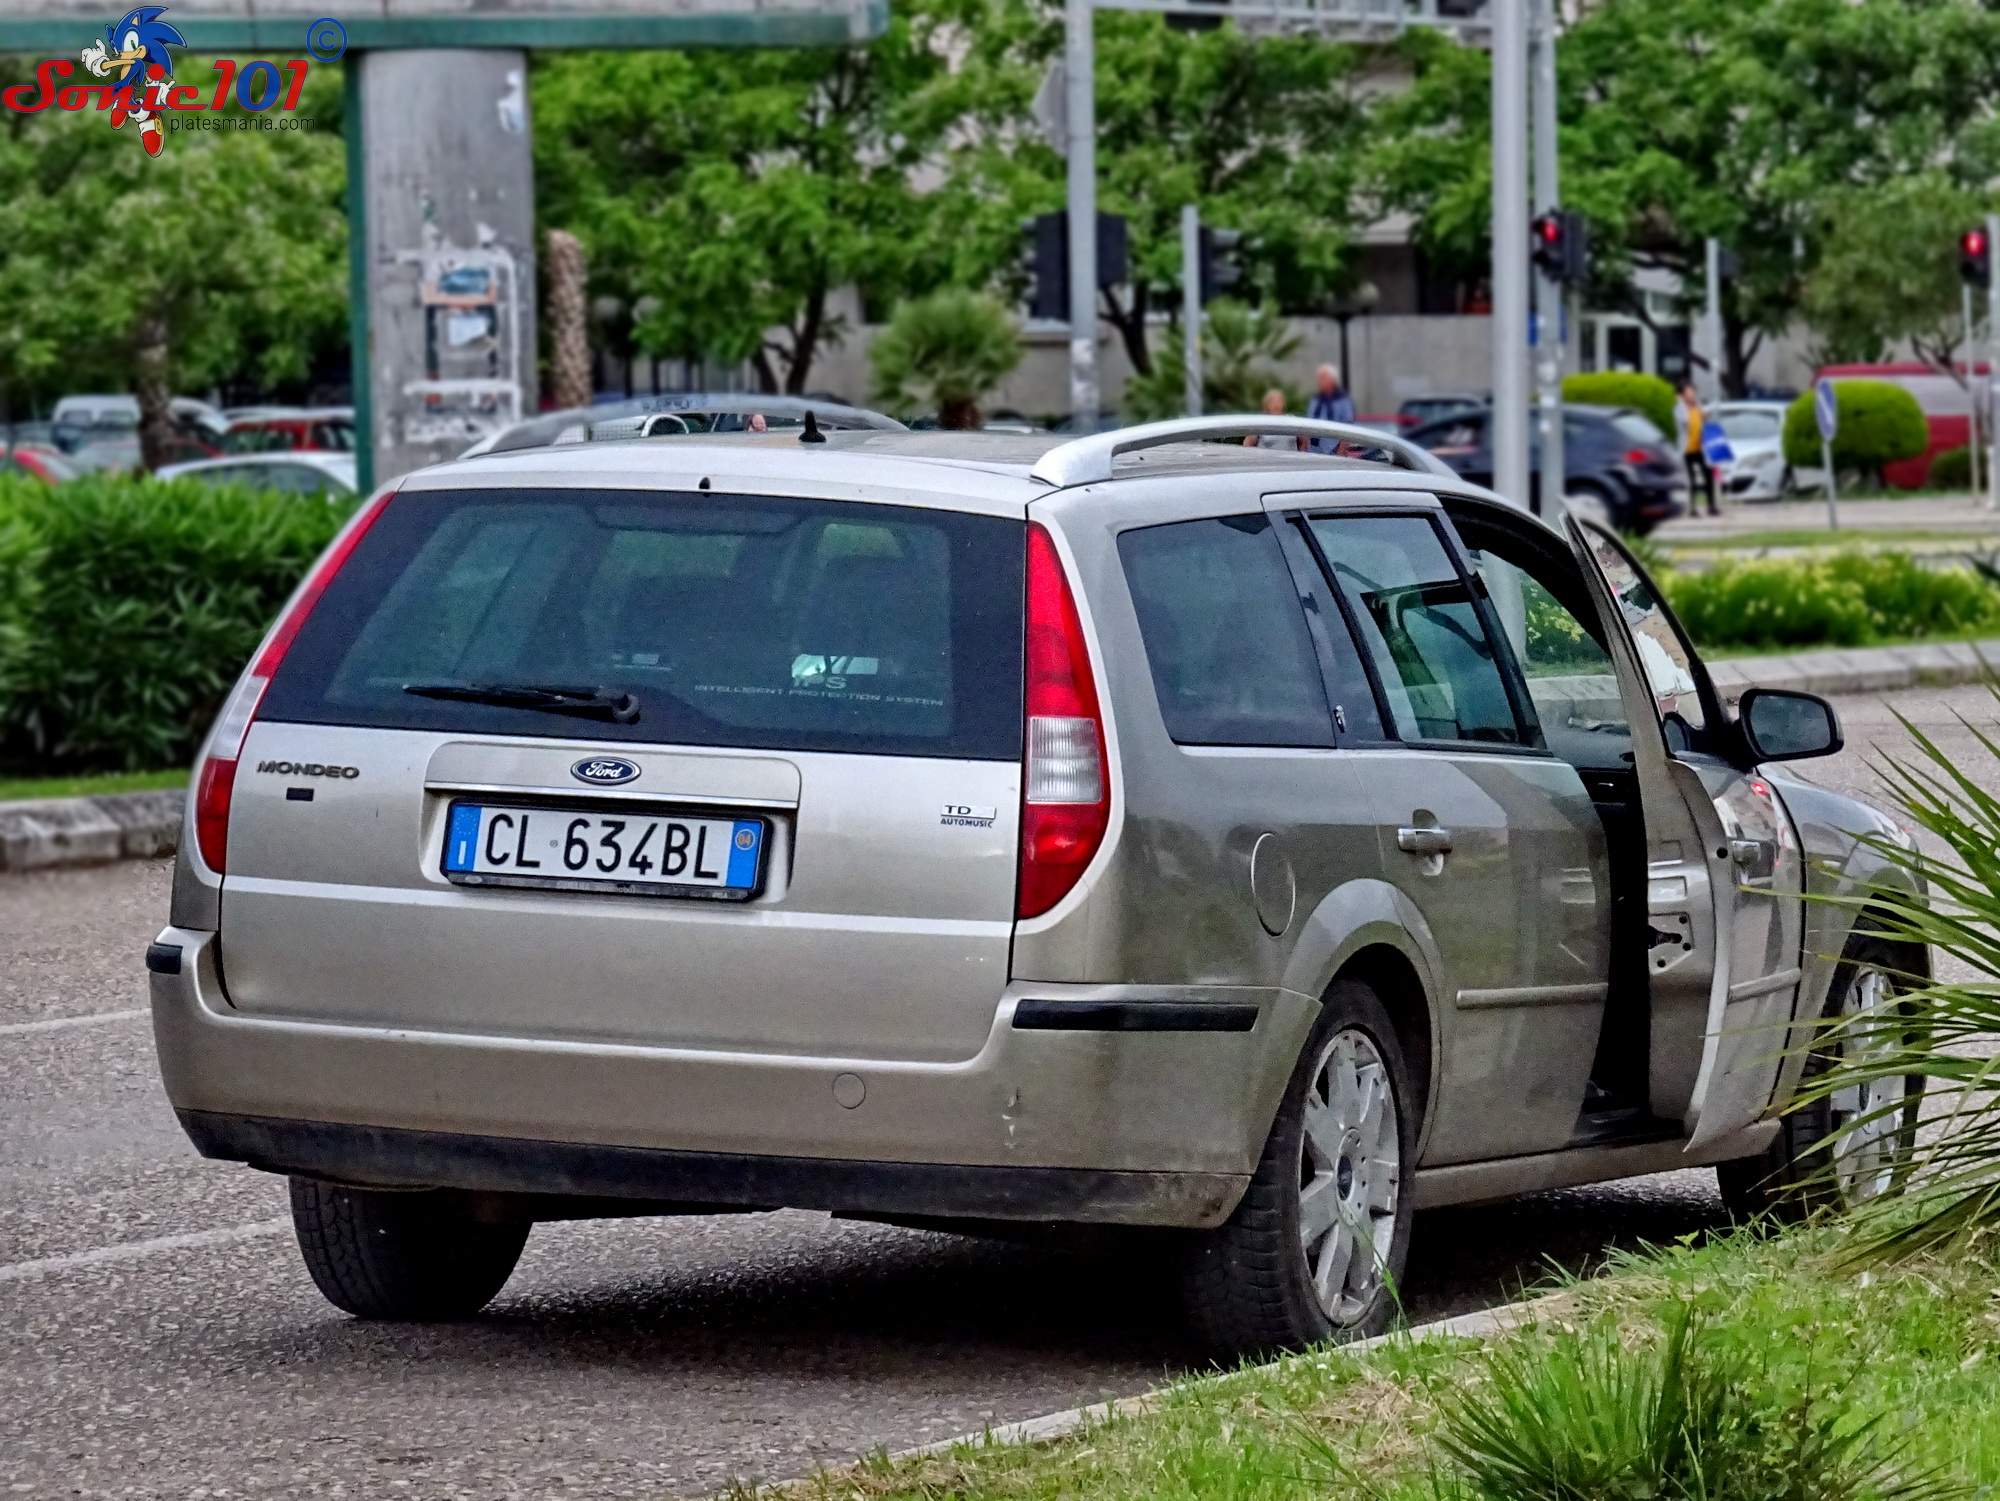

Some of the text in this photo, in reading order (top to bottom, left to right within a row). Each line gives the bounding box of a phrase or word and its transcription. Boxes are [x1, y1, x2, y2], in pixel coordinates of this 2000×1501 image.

[256, 760, 360, 779] MONDEO
[585, 761, 623, 778] Ford
[944, 804, 972, 815] TD
[940, 817, 994, 829] AUTOMUSIC
